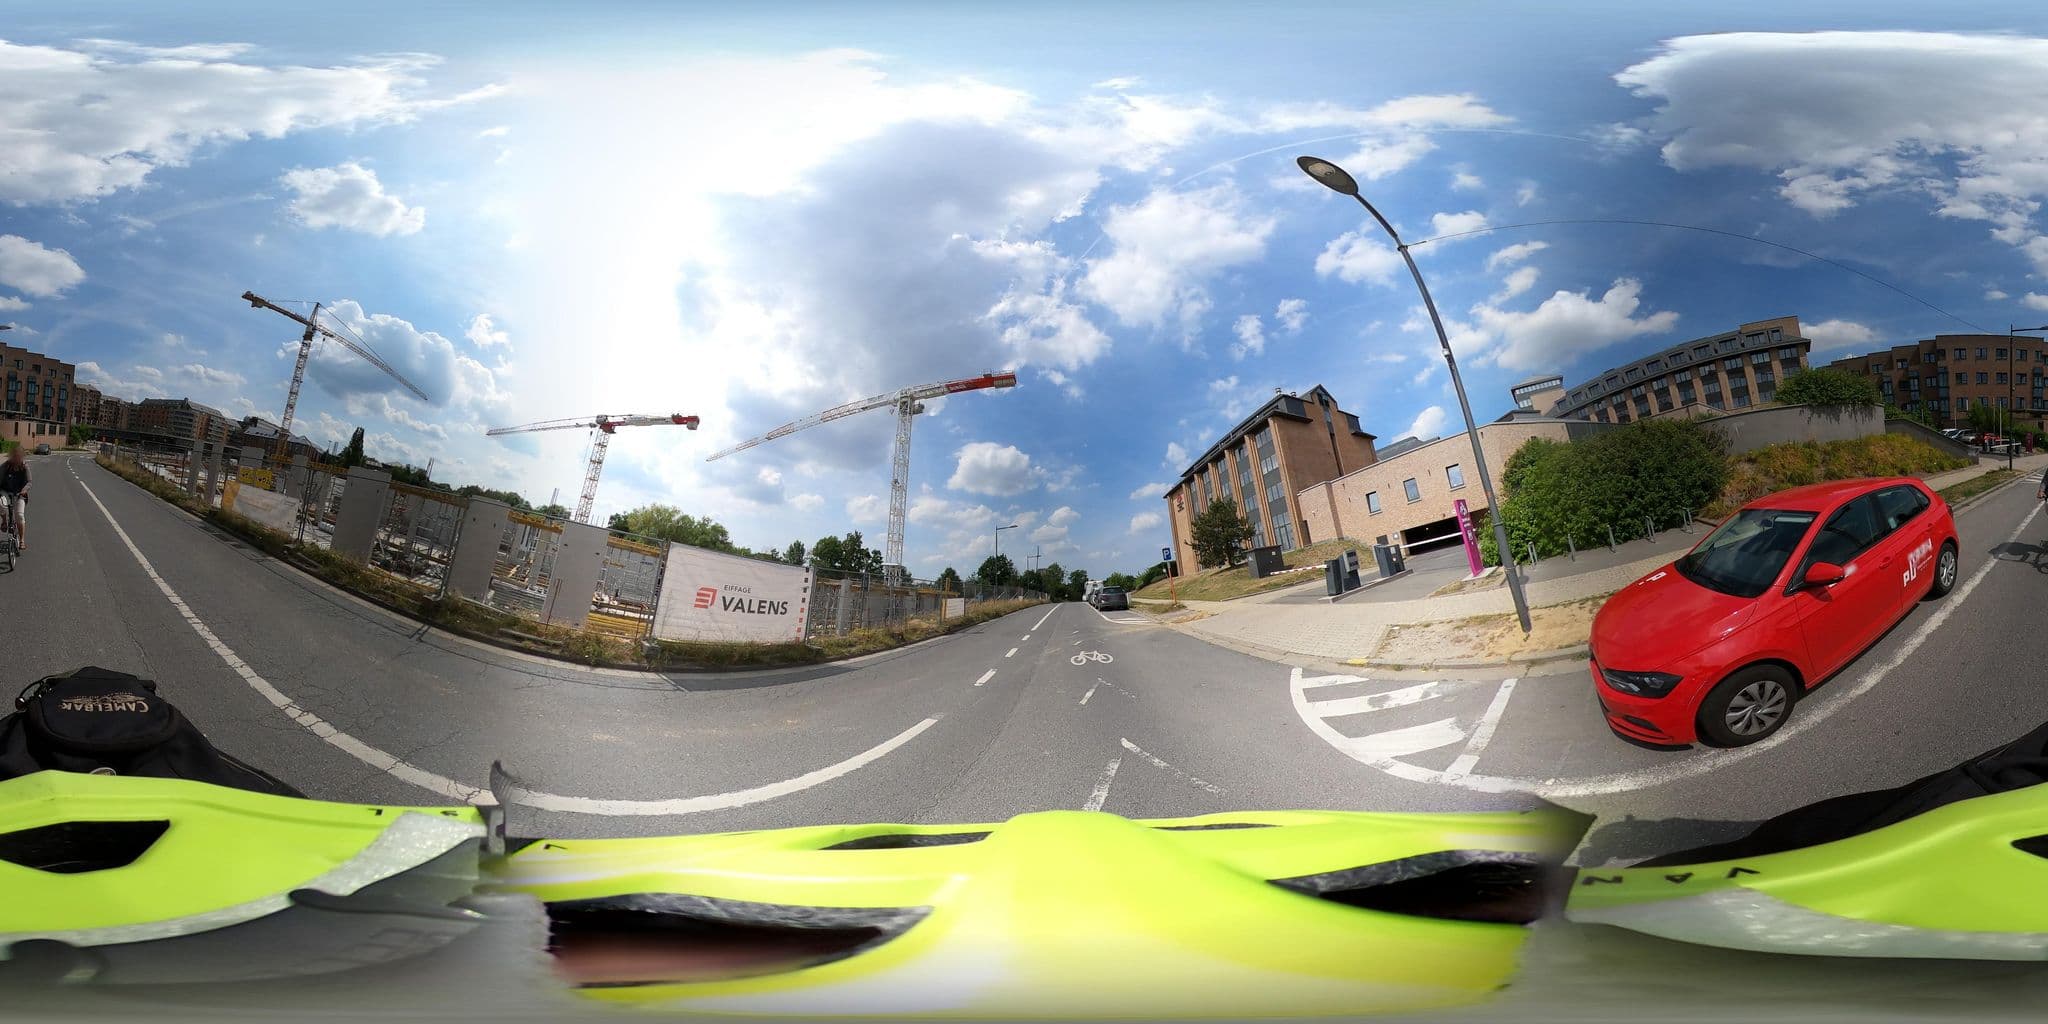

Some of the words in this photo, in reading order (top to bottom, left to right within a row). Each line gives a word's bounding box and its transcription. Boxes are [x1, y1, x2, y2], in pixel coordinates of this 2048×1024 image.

[723, 585, 752, 594] EIFFAGE
[722, 596, 788, 615] VALENS
[61, 701, 149, 713] CAMELBAK
